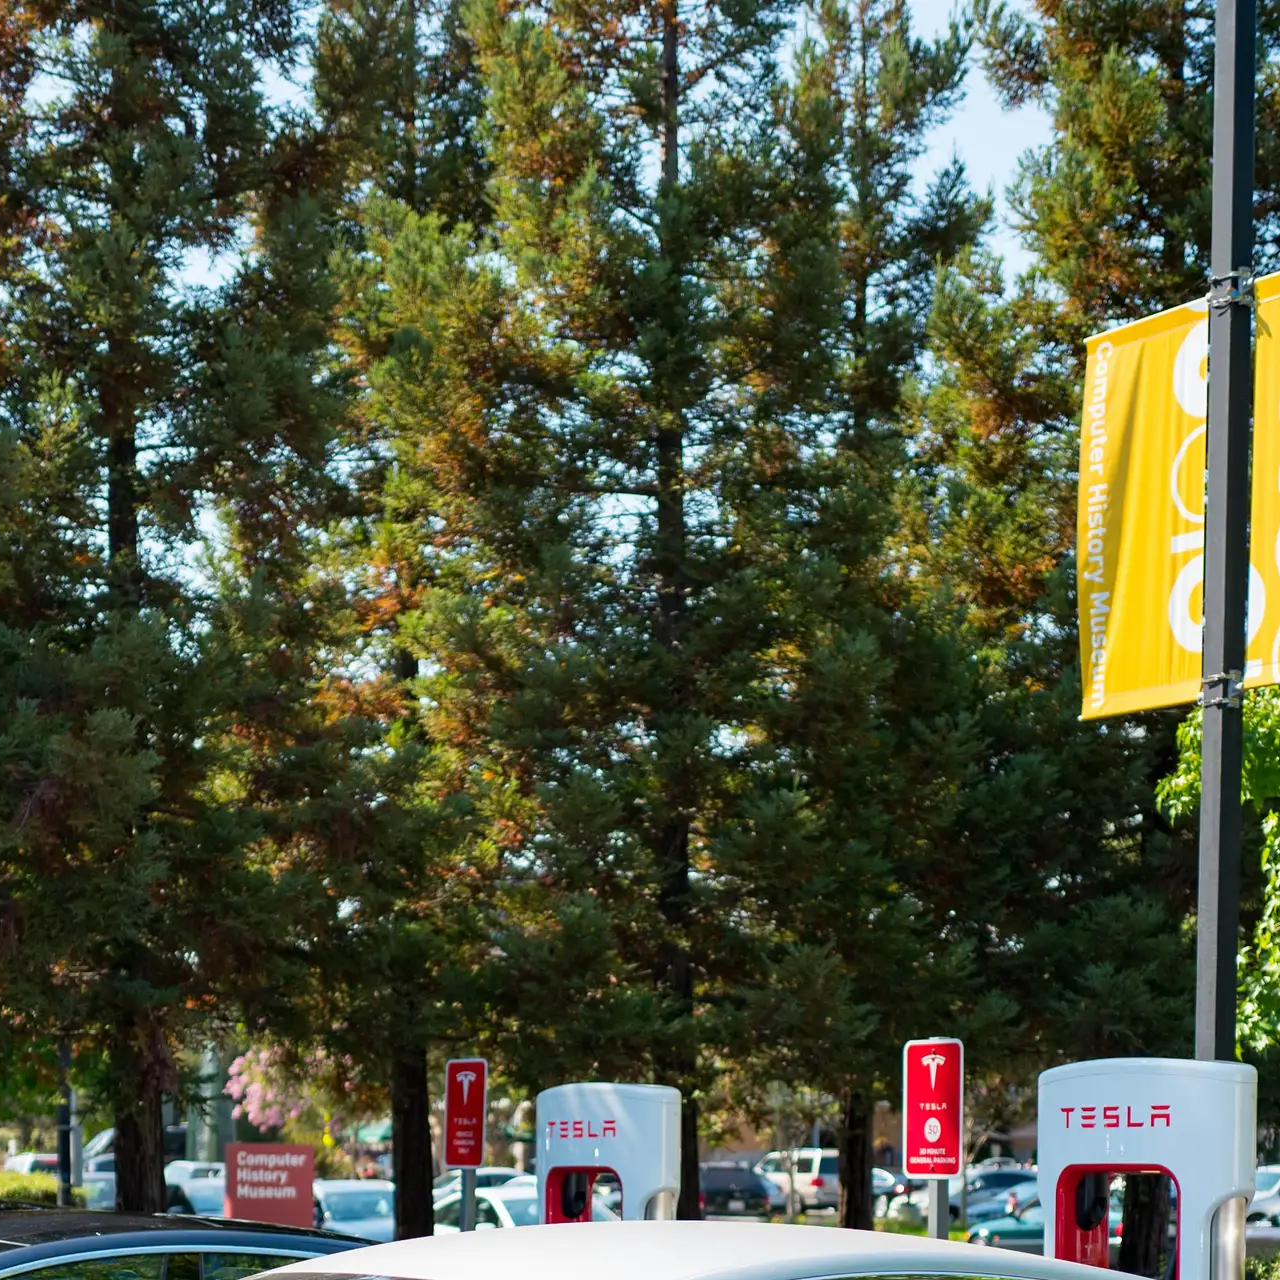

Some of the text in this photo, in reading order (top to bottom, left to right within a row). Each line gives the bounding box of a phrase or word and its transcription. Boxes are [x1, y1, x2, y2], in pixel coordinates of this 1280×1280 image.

[1083, 341, 1113, 708] Computer History Museum
[919, 1102, 947, 1111] TESLA
[1061, 1105, 1172, 1129] TESLA
[547, 1119, 616, 1139] TESLA
[927, 1124, 939, 1135] 30
[237, 1151, 307, 1169] Computer
[237, 1168, 289, 1186] History
[237, 1184, 297, 1199] Museum
